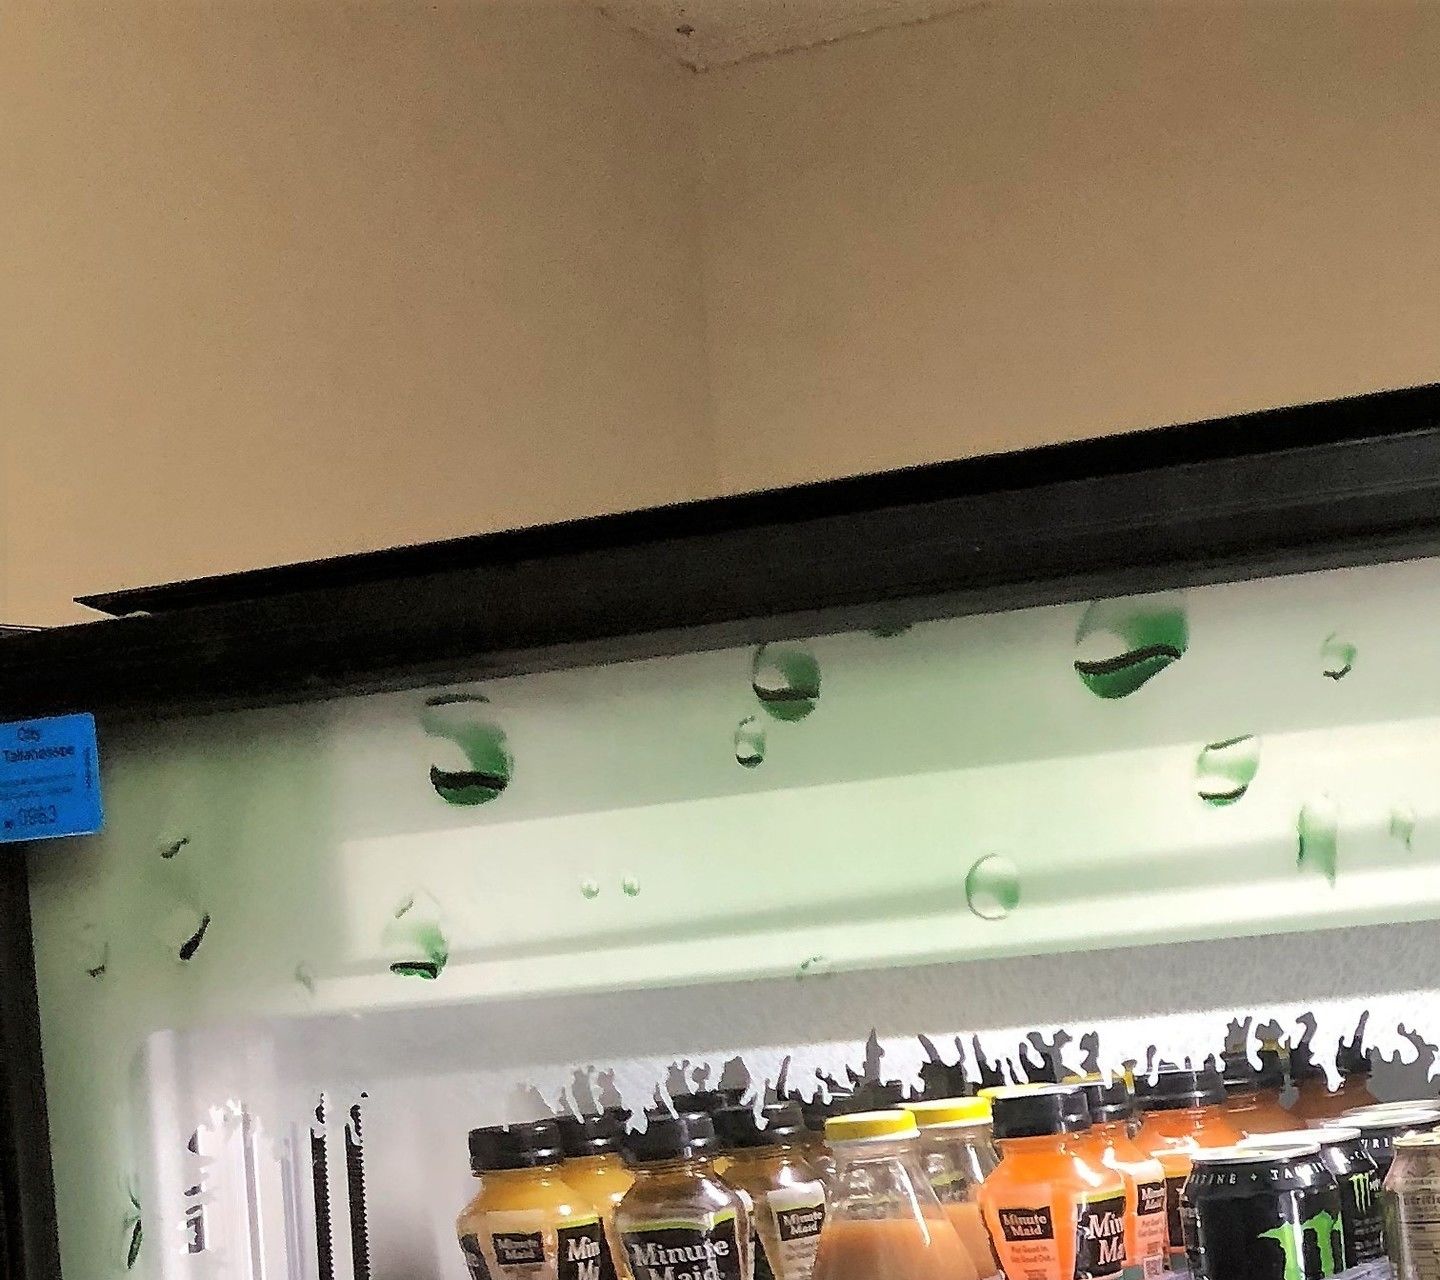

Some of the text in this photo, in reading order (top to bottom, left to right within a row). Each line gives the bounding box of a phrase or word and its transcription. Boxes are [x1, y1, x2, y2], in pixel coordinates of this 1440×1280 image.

[1002, 1213, 1047, 1225] Minute
[1011, 1224, 1042, 1237] Maid
[631, 1238, 729, 1268] Minute
